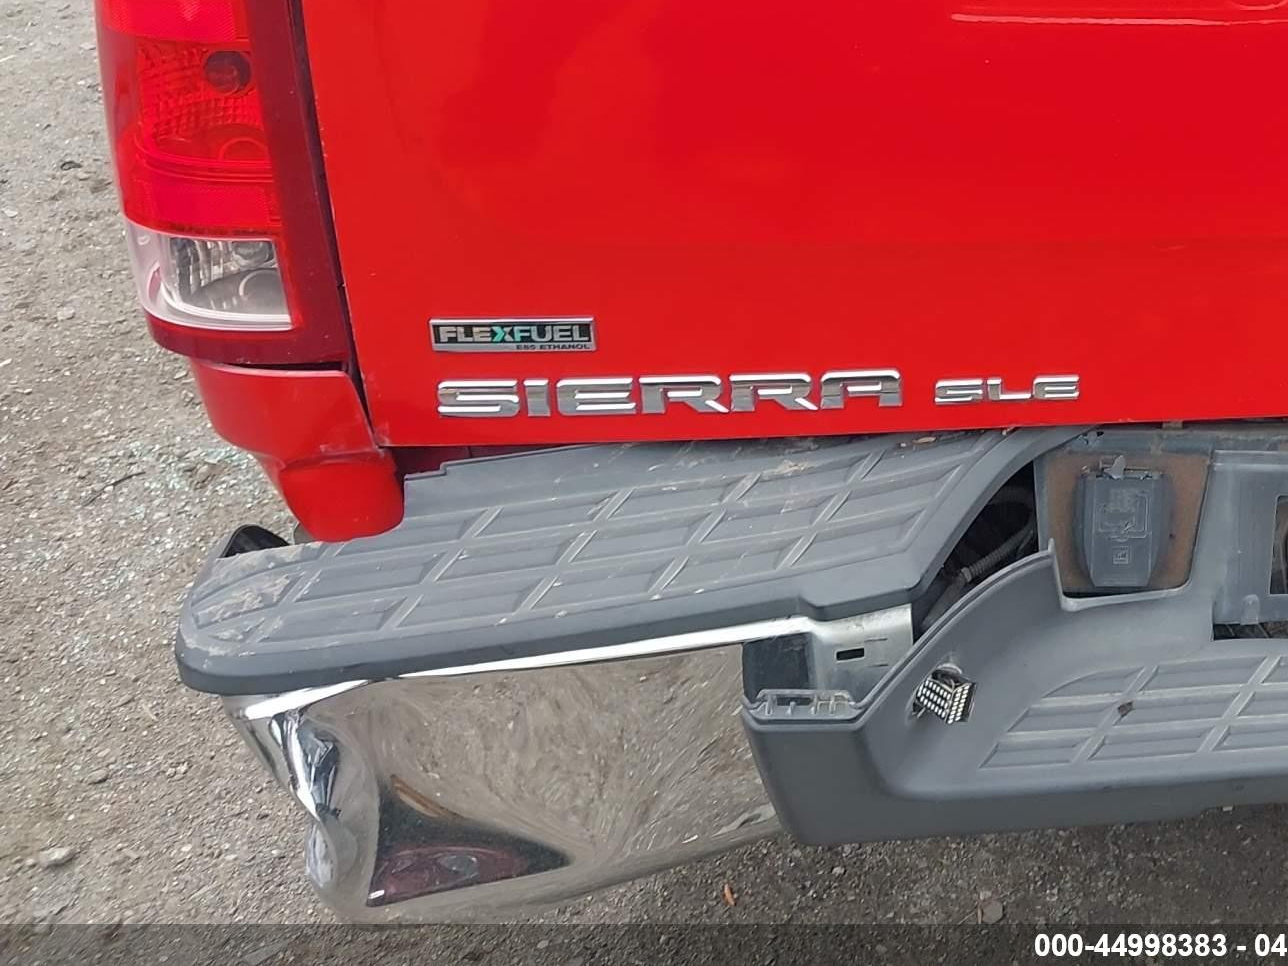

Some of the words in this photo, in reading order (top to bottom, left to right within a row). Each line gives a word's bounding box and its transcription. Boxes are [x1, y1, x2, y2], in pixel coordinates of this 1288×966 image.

[439, 326, 590, 343] FLEXFUEL
[437, 369, 903, 417] SIERRA
[934, 374, 1081, 404] SLE
